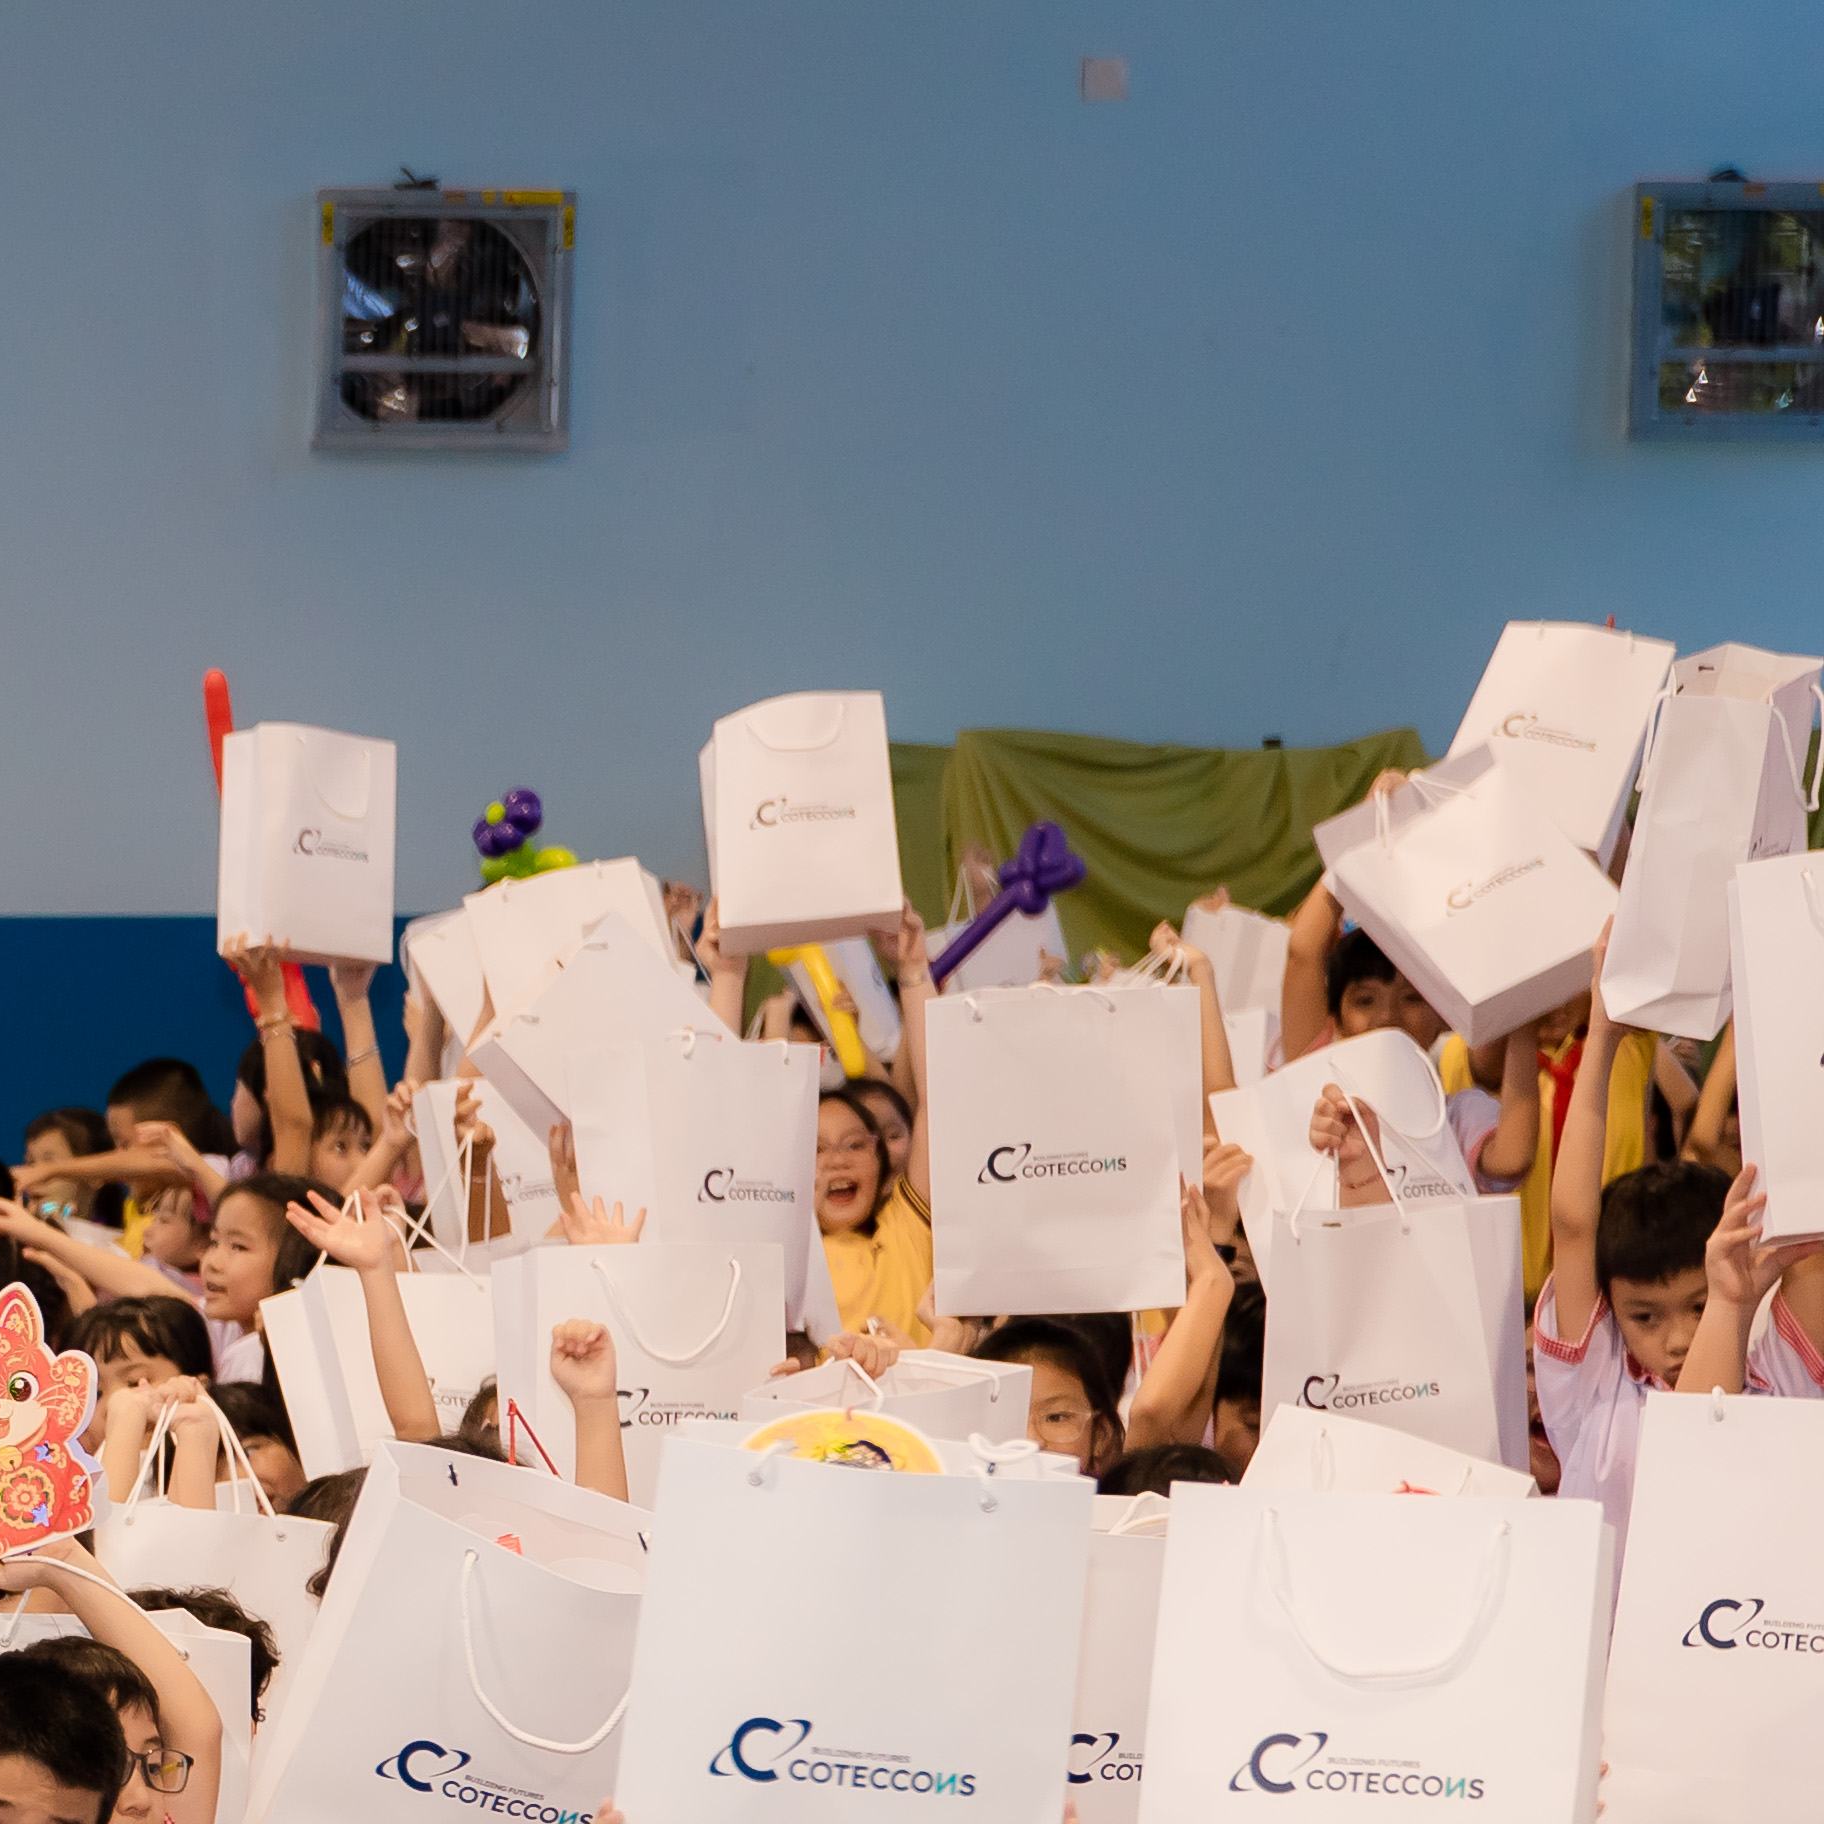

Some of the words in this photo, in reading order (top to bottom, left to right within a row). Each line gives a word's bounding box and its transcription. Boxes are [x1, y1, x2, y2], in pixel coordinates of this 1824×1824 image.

[1023, 1158, 1126, 1179] COTECCONS
[1333, 1383, 1439, 1409] COTECCONS
[1746, 1630, 1824, 1653] COTEC
[789, 1759, 976, 1796] COTECCONS
[1306, 1770, 1484, 1799] COTECCONS
